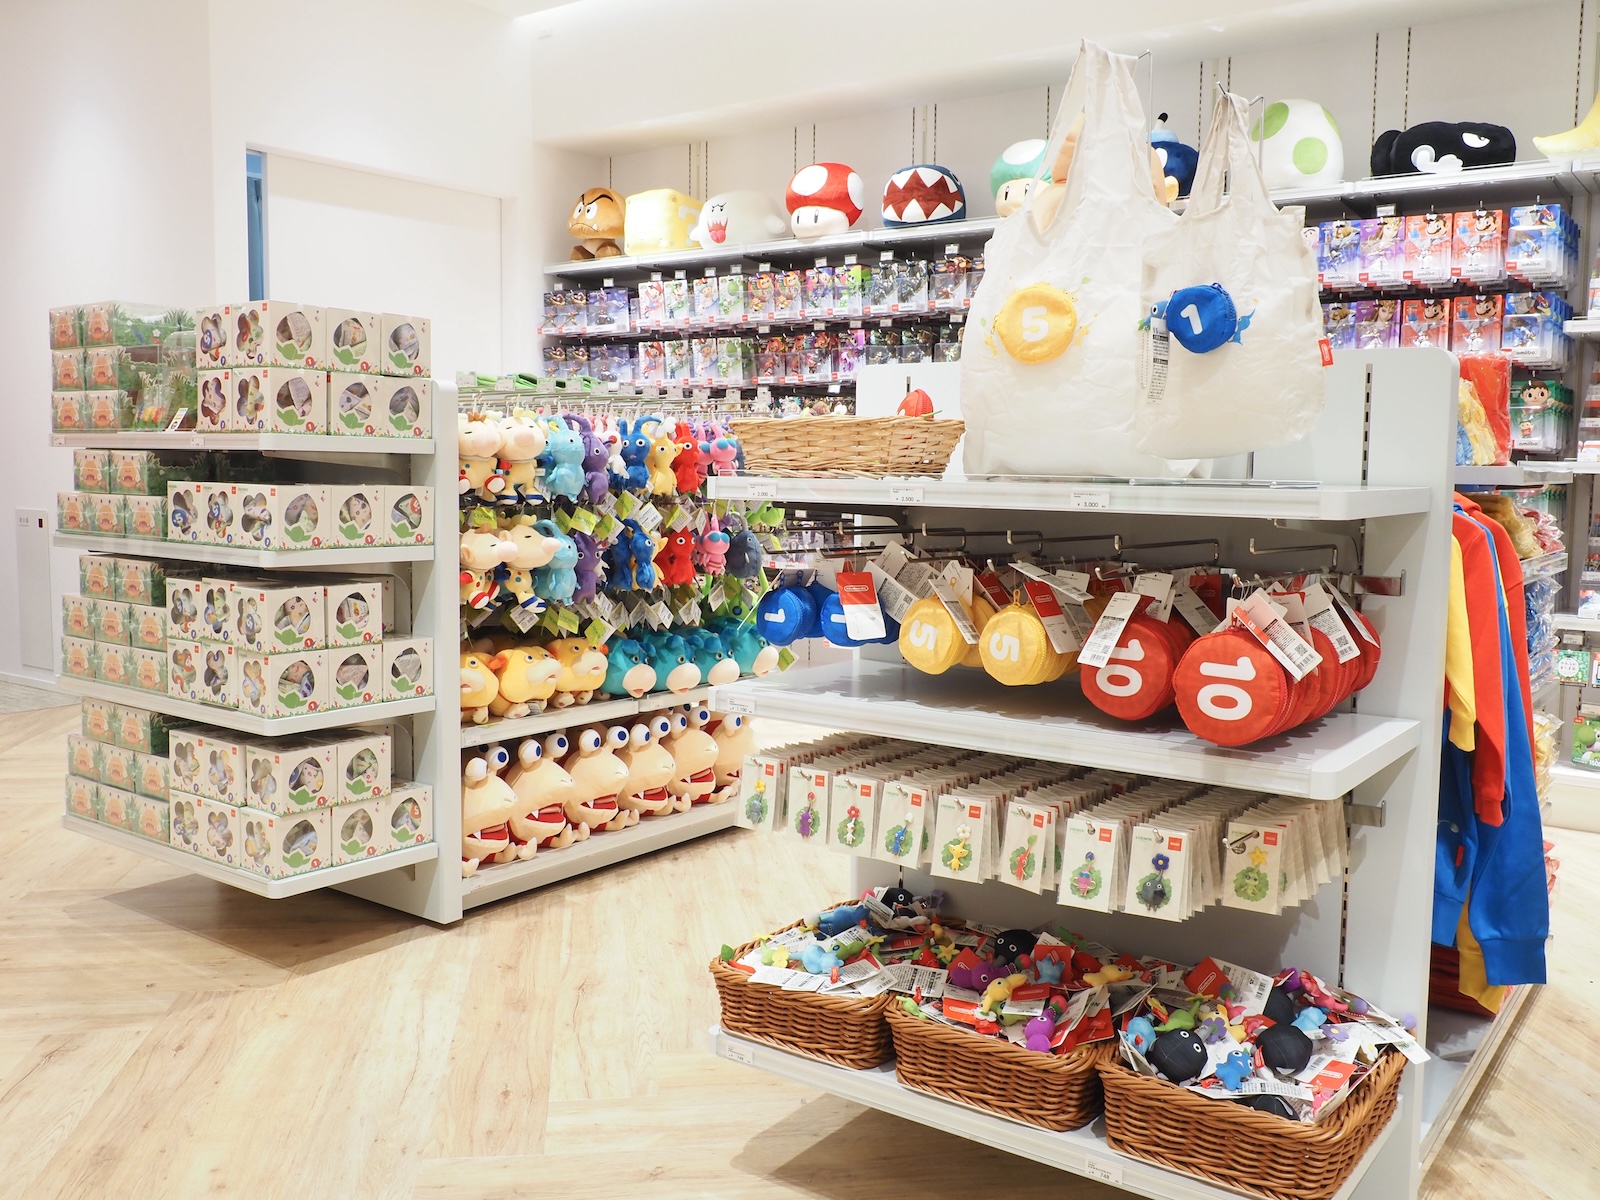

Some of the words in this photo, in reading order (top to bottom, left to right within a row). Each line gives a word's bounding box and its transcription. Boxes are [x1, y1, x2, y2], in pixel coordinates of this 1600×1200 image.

[1021, 306, 1049, 343] 5
[1180, 304, 1203, 335] 1
[764, 608, 786, 623] 1
[909, 620, 938, 651] 5
[989, 632, 1020, 662] 5
[1096, 638, 1145, 697] 10
[1197, 656, 1256, 721] 10
